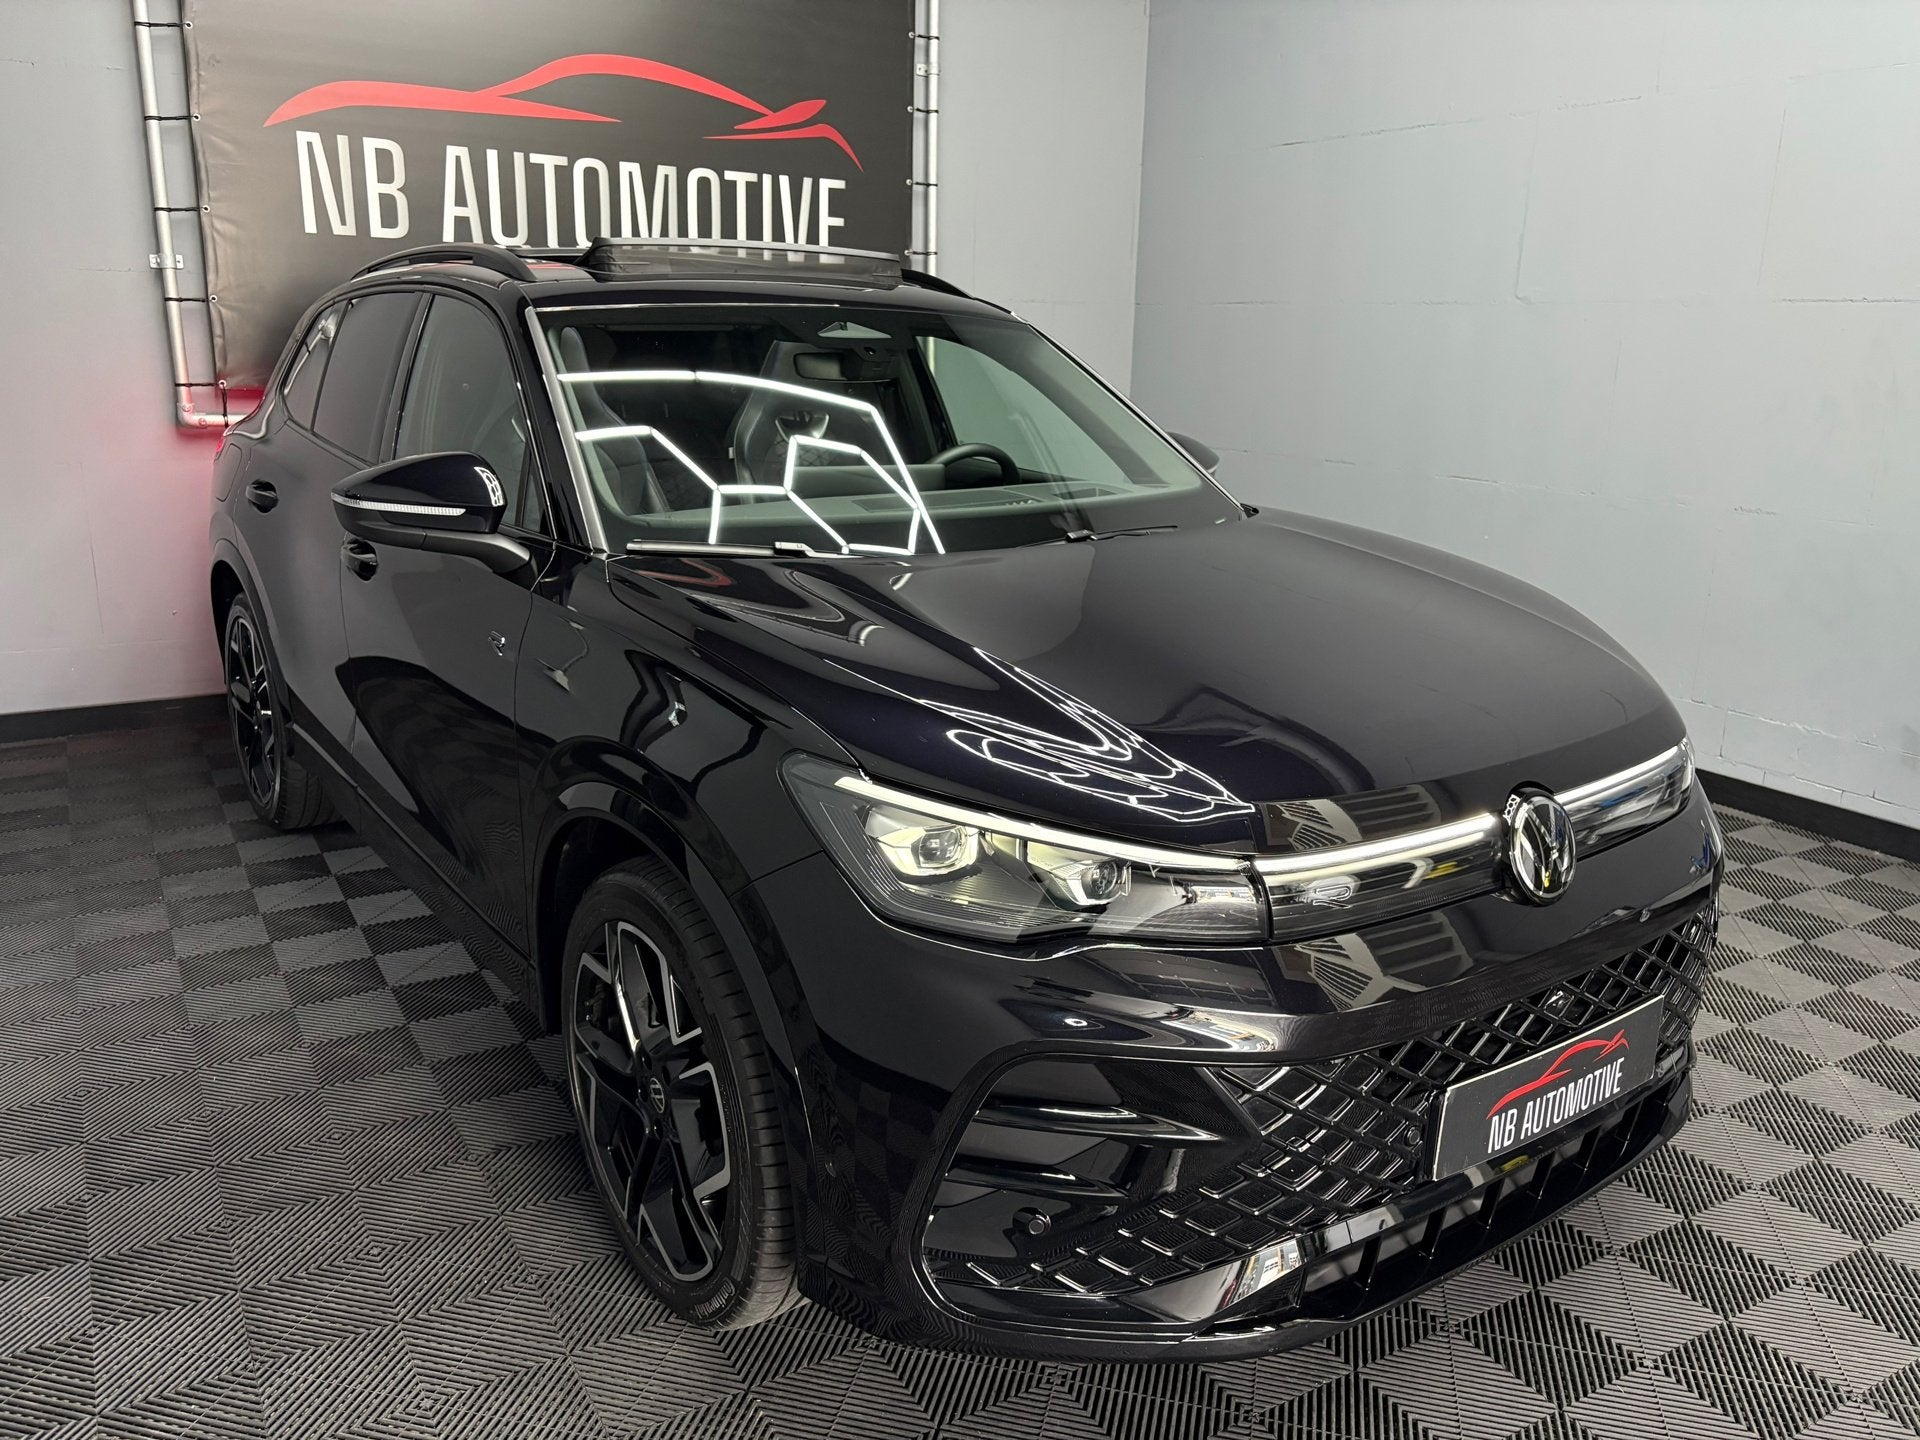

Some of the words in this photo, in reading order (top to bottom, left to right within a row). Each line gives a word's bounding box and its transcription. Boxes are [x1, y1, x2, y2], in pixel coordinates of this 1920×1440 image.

[296, 130, 409, 239] NB
[442, 144, 846, 258] AUTOMOTIVE
[1487, 1108, 1518, 1154] NB
[1520, 1057, 1625, 1140] AUTOMOTIVE
